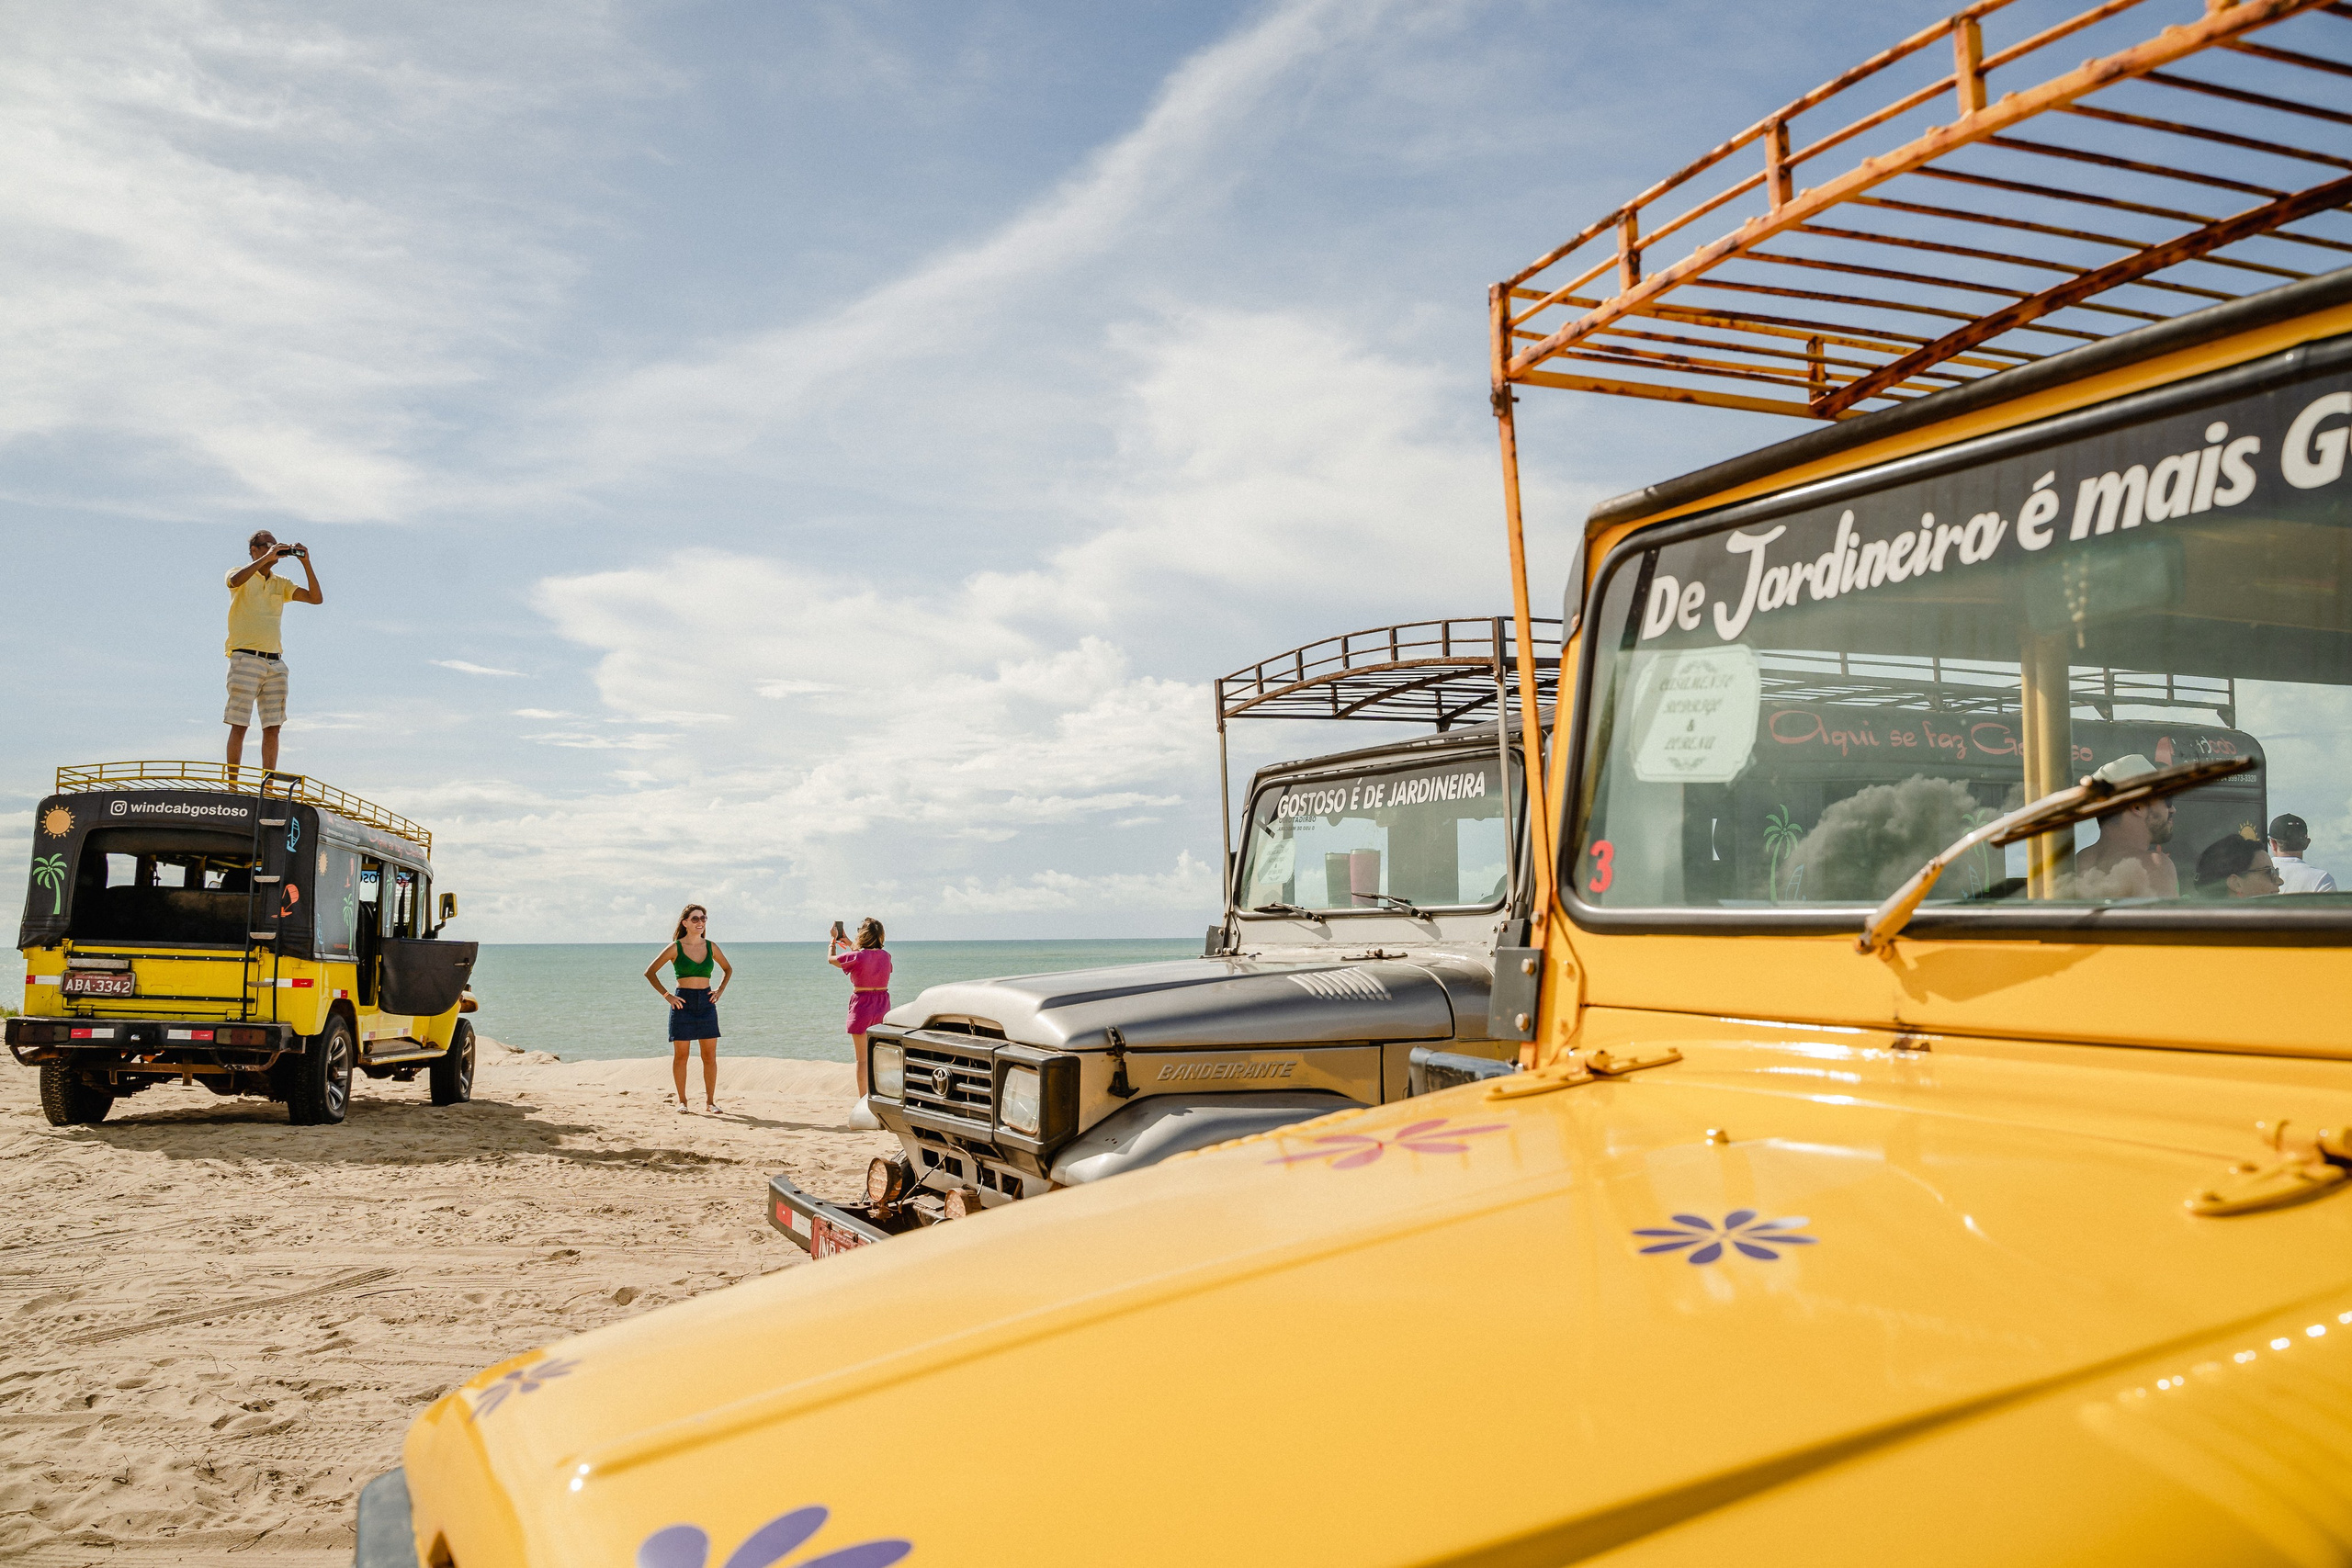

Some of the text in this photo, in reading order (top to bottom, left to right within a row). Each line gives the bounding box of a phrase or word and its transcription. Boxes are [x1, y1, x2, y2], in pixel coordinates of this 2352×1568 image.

[1642, 574, 1706, 640] De
[1713, 509, 2008, 641] Jardineira
[2017, 470, 2060, 551] é
[2069, 421, 2261, 541] mais
[1769, 710, 1880, 757] Aqui
[1891, 728, 1917, 748] se
[1922, 720, 1968, 760] faz
[130, 801, 249, 818] windcabgostoso
[1277, 772, 1486, 818] GOSTOSO É DE JARDINEIRA
[1589, 840, 1614, 893] 3
[1157, 1060, 1297, 1081] BANDEIRANTE
